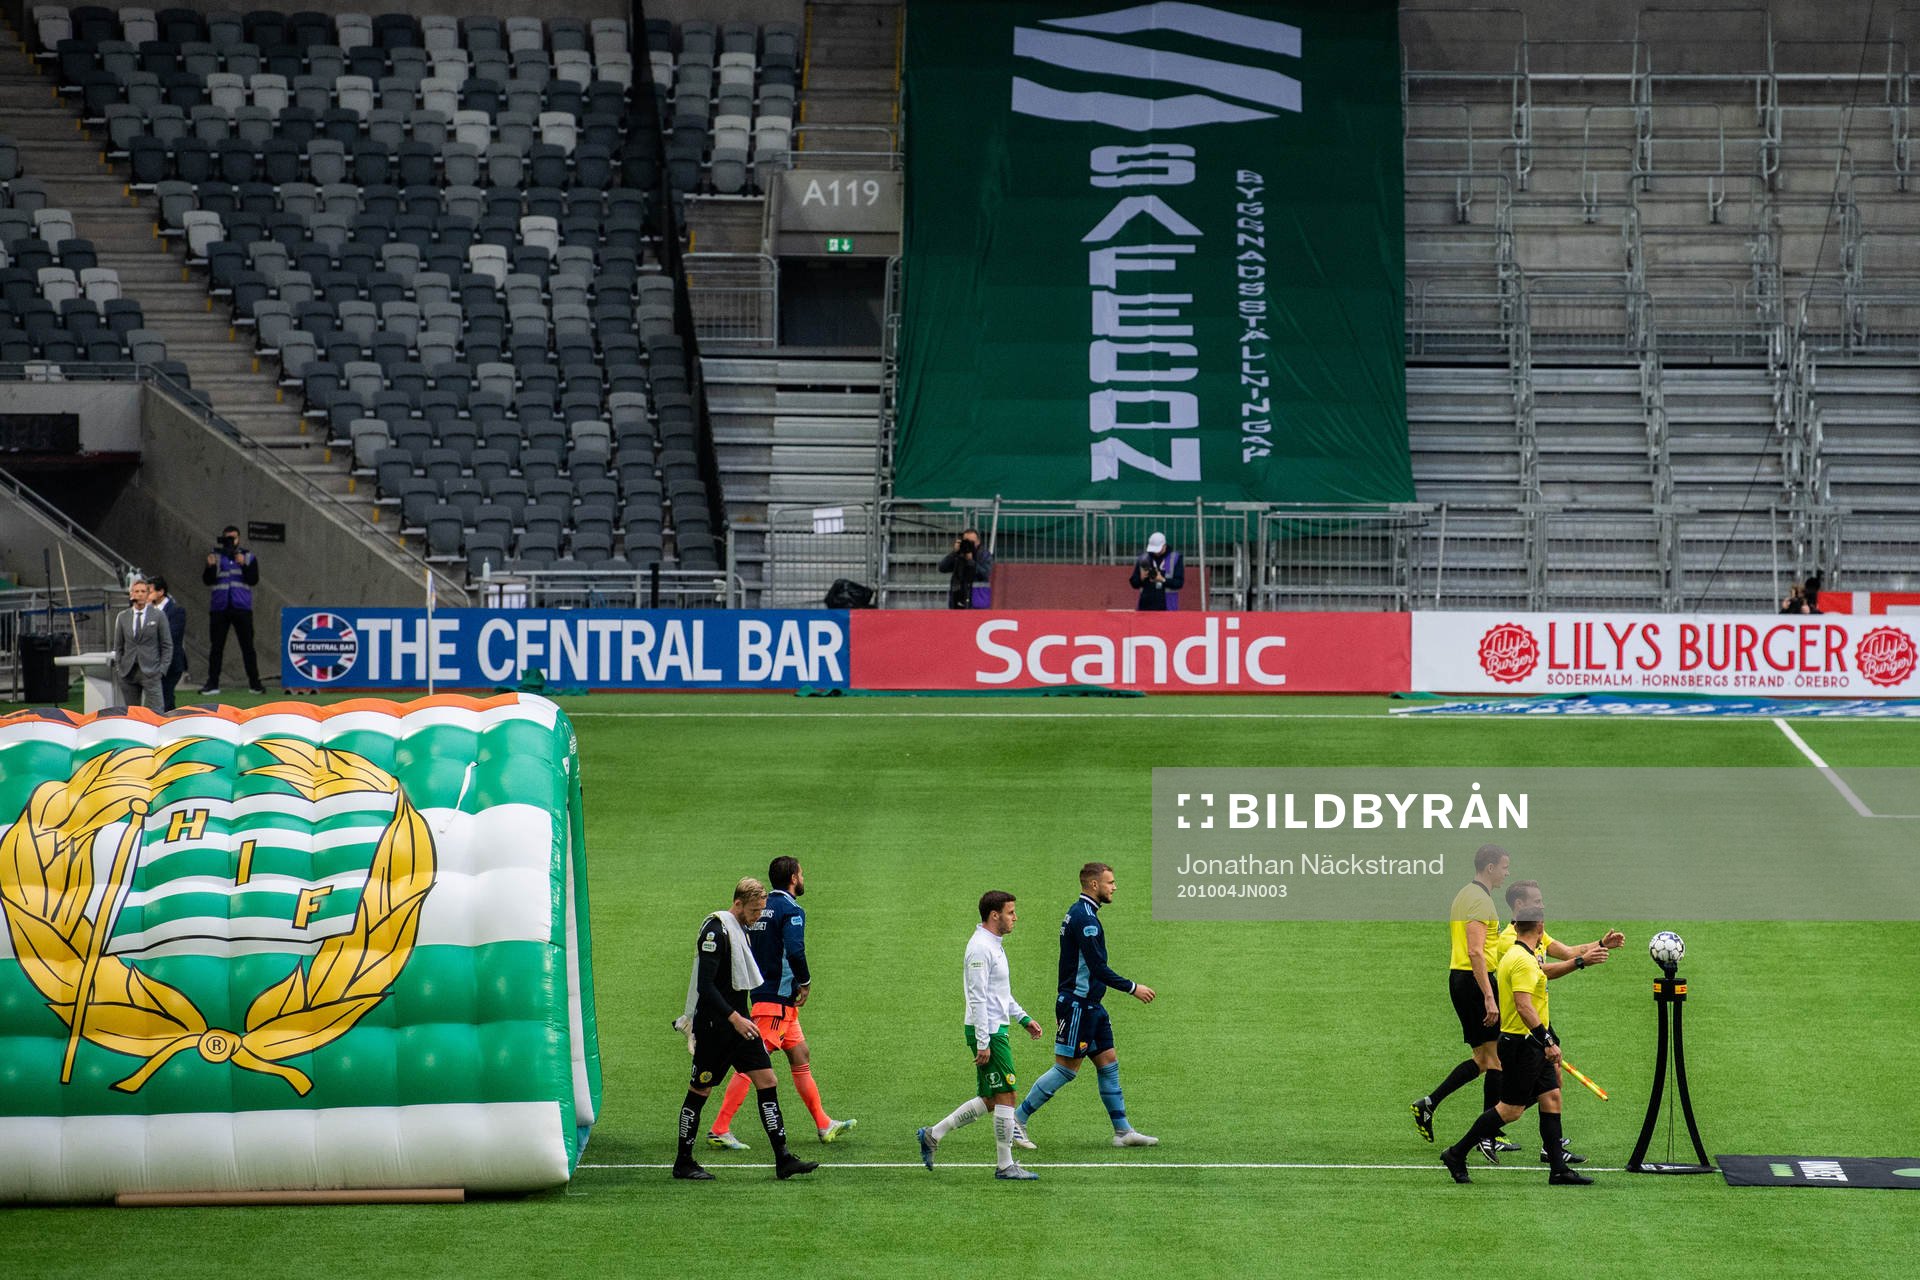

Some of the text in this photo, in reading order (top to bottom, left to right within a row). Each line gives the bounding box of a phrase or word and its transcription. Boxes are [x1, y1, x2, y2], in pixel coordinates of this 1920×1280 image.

[802, 179, 880, 206] A119
[292, 643, 355, 652] THE CENTRAL BAR
[357, 617, 844, 682] THE CENTRAL BAR
[975, 617, 1287, 686] Scandic
[1548, 621, 1849, 673] LILYS BURGER
[1546, 672, 1850, 688] SÖDERMALM HORNSBERGS STRAND ÖREBRO
[680, 1106, 696, 1139] Clinton
[761, 1101, 780, 1132] Clinton
